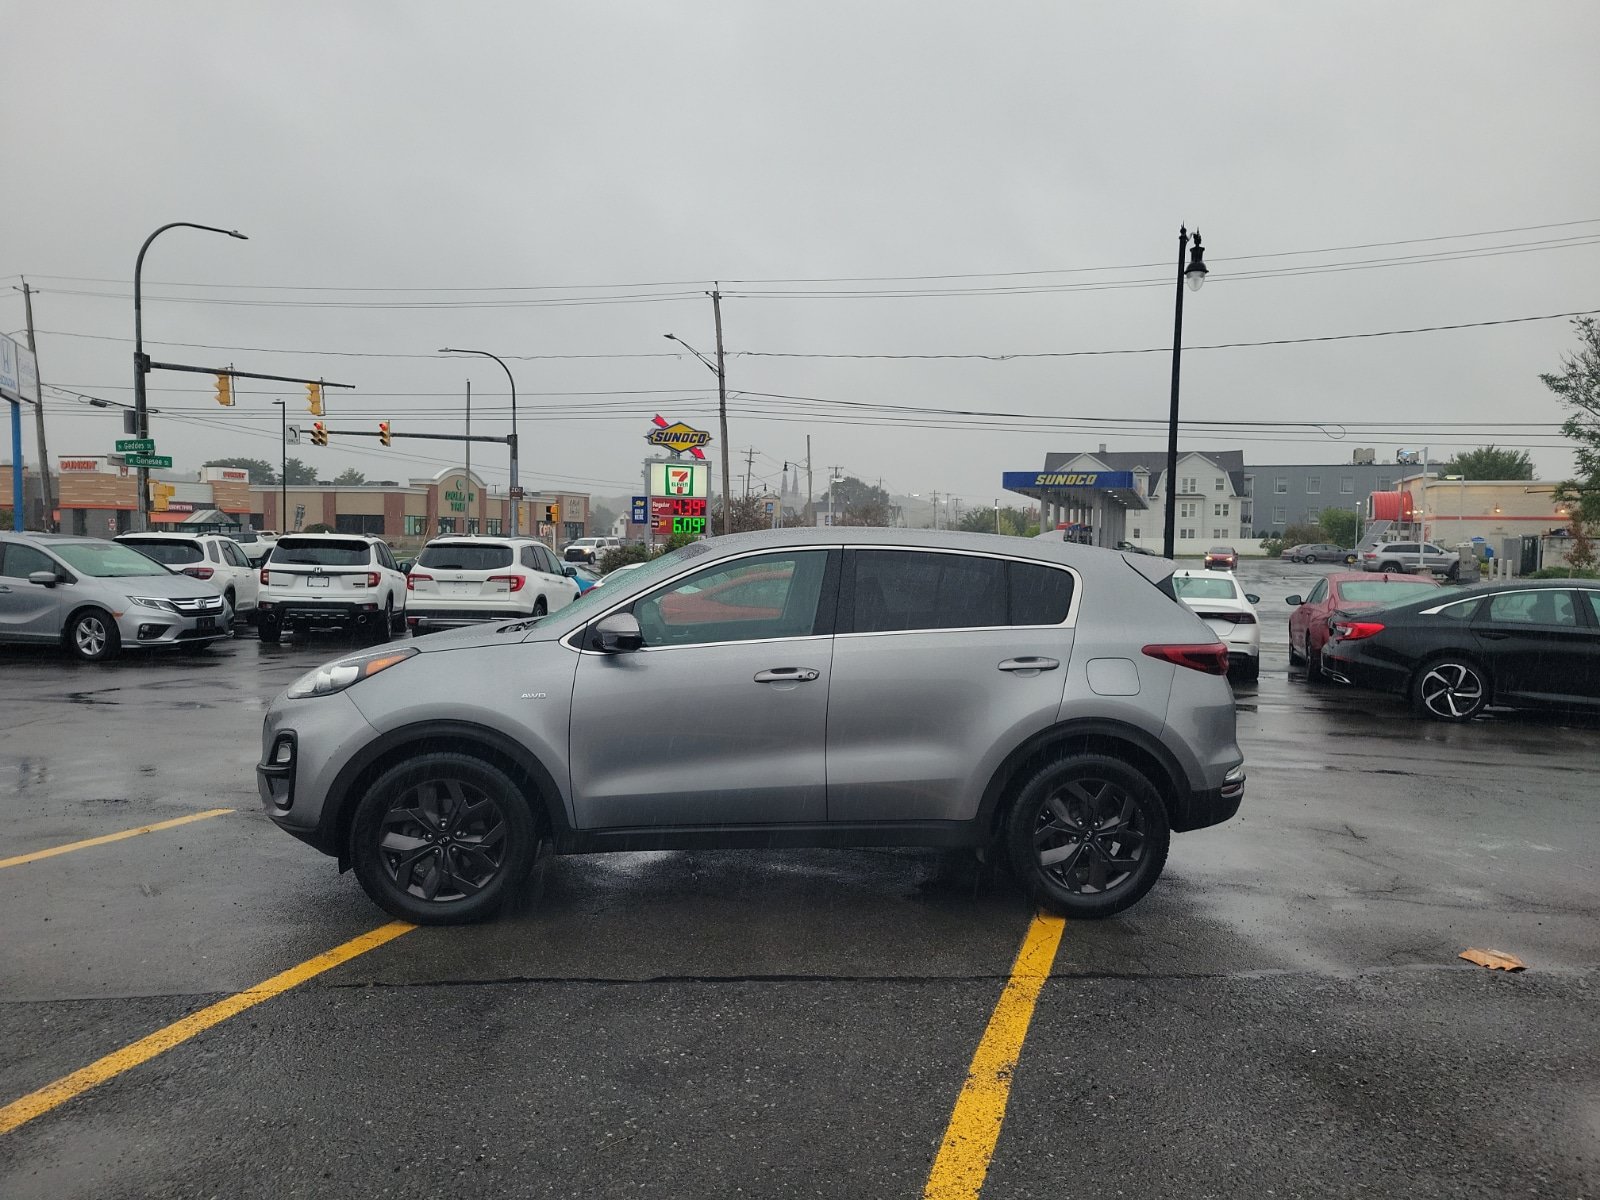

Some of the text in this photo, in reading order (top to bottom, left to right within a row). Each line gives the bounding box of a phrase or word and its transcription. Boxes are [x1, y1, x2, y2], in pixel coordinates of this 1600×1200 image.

[654, 431, 708, 444] SUNOCO
[124, 442, 145, 450] Geddes
[136, 457, 163, 466] Genesee
[672, 471, 688, 494] 7
[1035, 474, 1097, 485] SUNOCO
